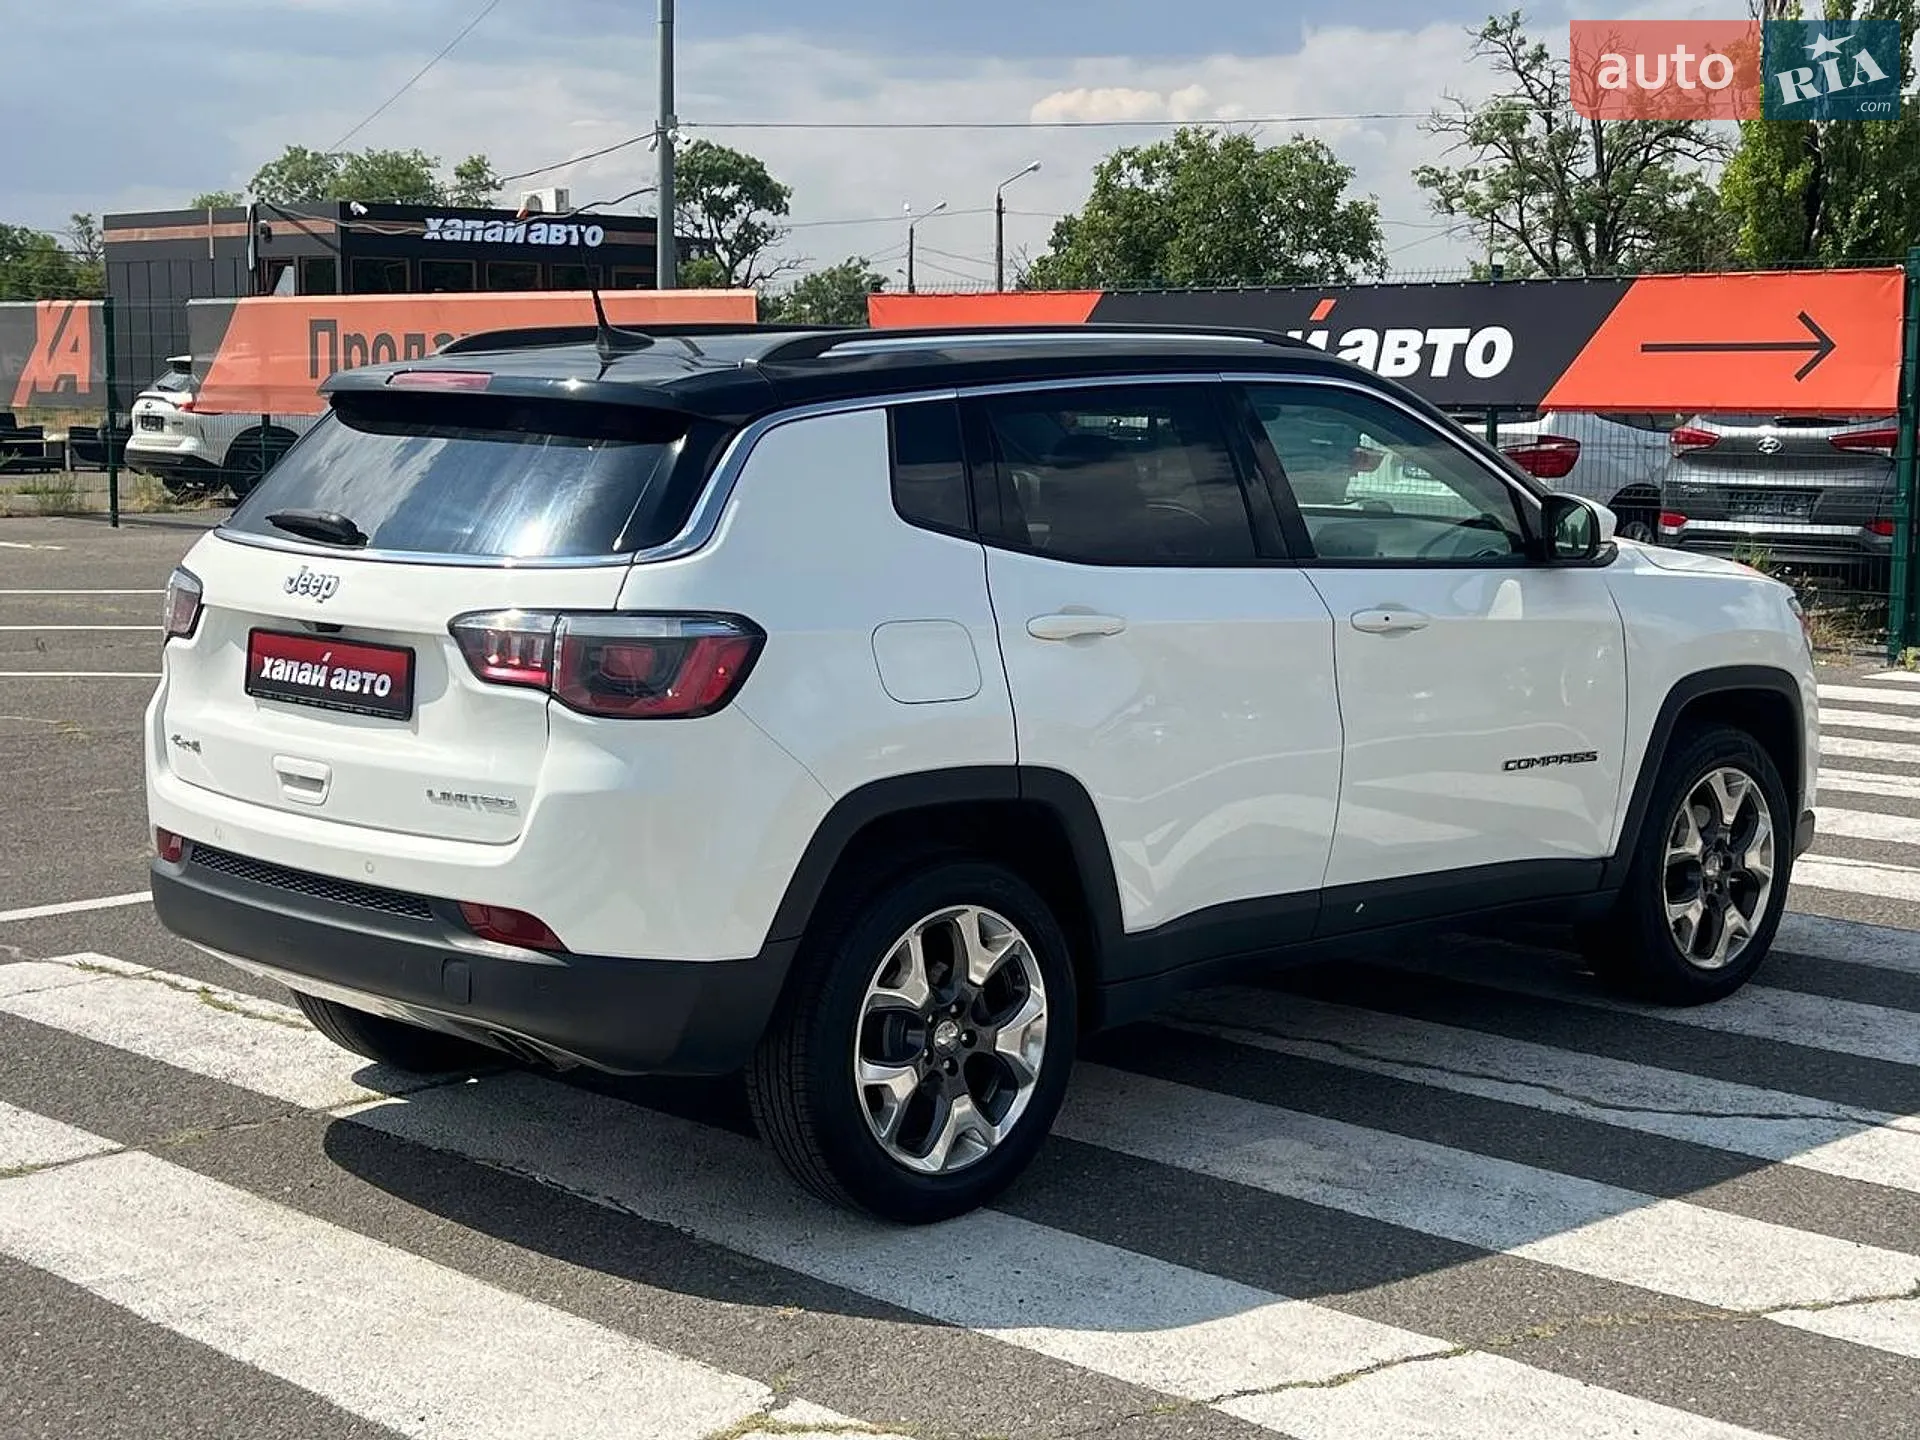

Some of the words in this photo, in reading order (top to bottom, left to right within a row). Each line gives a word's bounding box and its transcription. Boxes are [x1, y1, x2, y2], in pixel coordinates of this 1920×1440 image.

[422, 205, 528, 244] хапай
[527, 222, 604, 248] авто
[284, 565, 341, 603] Jeep
[260, 652, 332, 688] хапай
[329, 666, 392, 698] авто
[1502, 750, 1599, 771] COMPASS
